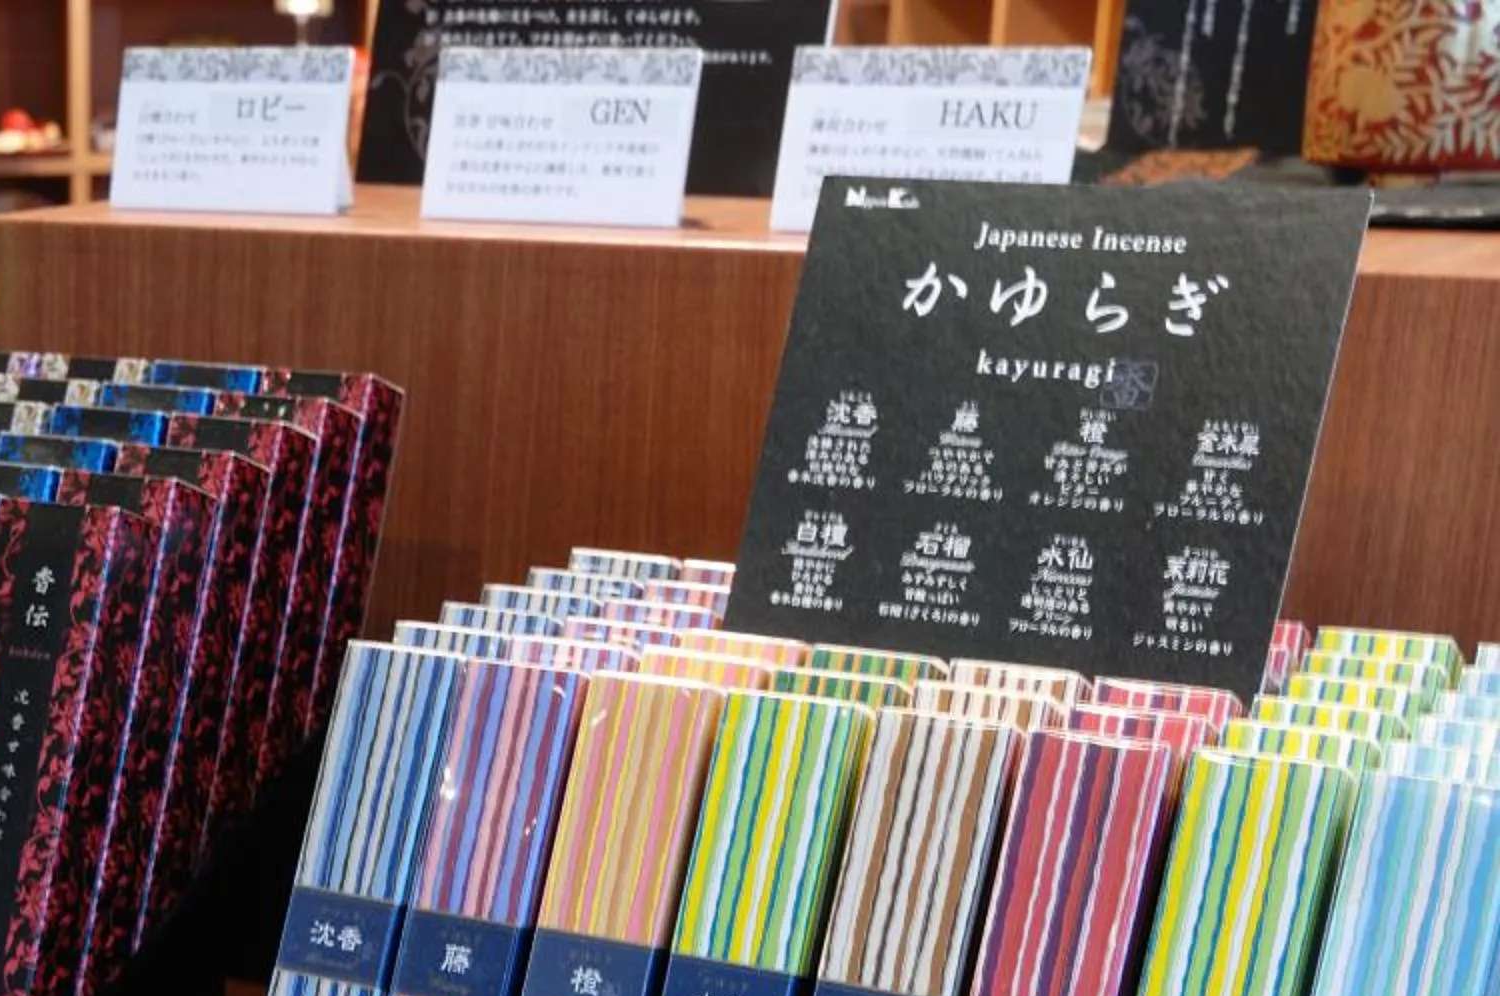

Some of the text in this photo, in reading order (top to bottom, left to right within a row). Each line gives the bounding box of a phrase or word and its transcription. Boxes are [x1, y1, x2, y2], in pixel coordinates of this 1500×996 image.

[236, 95, 307, 122] ロビー
[589, 97, 652, 126] GEN
[938, 100, 1039, 131] HAKU
[973, 221, 1188, 255] Japanese Incense
[902, 261, 1230, 338] かゆらぎ
[976, 348, 1116, 390] kayuragi
[827, 400, 878, 425] 沈香
[914, 531, 972, 559] 石榴
[1037, 544, 1093, 571] 水仙
[1163, 555, 1232, 586] 茉莉花
[24, 565, 56, 629] 香伝
[309, 919, 364, 952] 沈香
[439, 943, 474, 976] 藤
